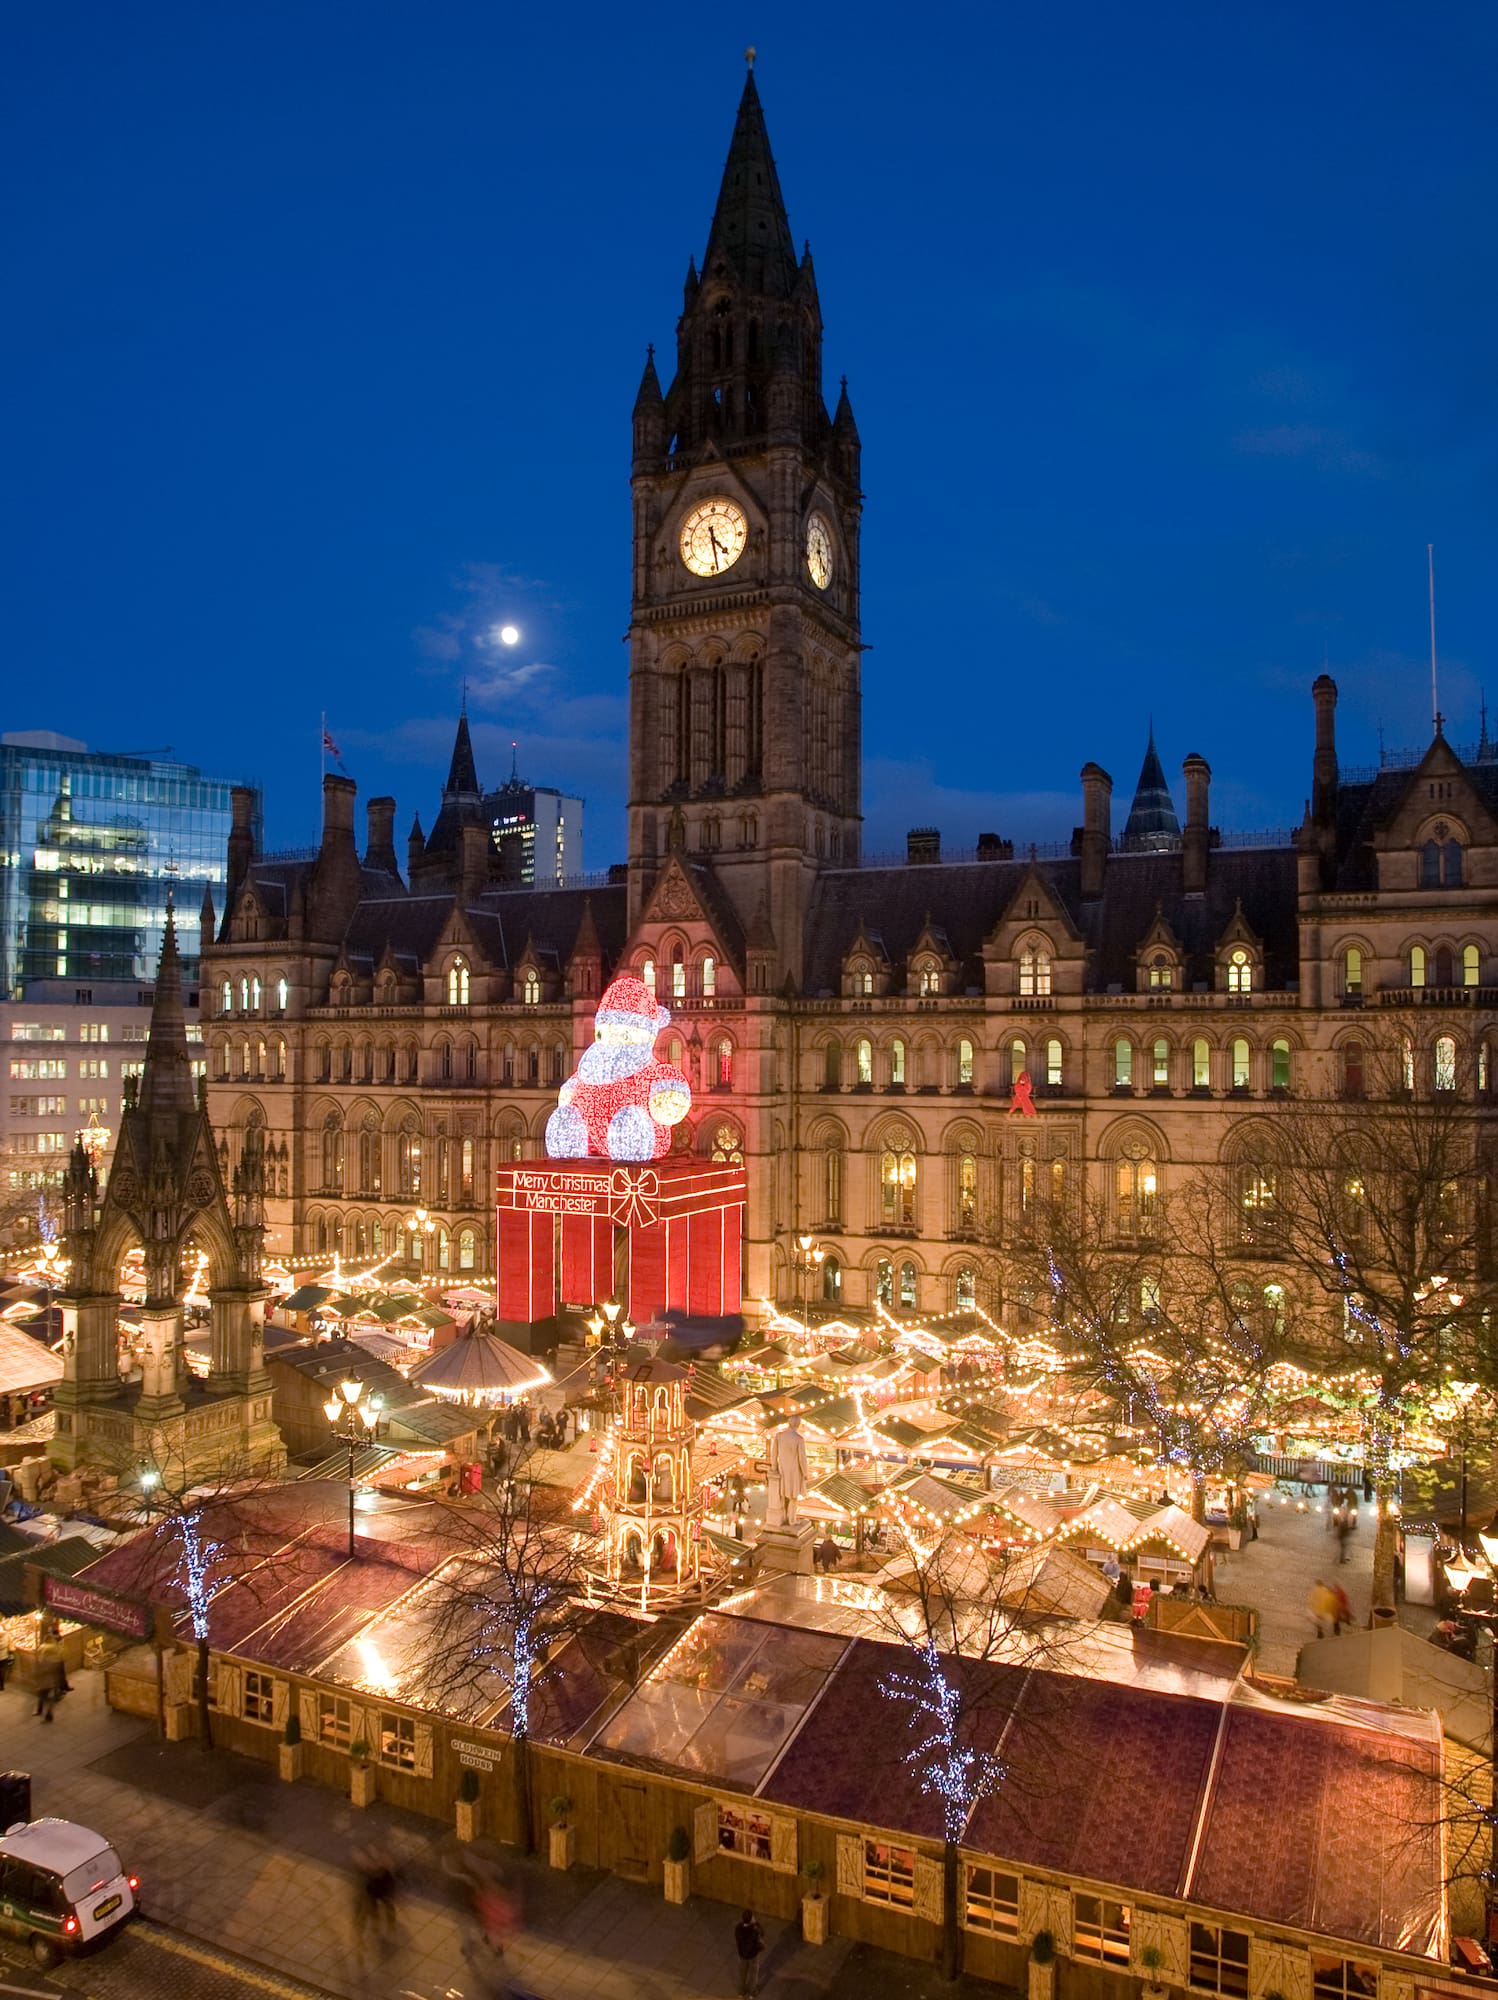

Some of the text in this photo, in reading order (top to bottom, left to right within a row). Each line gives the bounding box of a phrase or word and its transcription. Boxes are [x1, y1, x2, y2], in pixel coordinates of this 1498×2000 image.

[514, 1173, 609, 1193] Merry Christmas
[526, 1192, 597, 1212] Manchester
[461, 1754, 492, 1770] HOUSE
